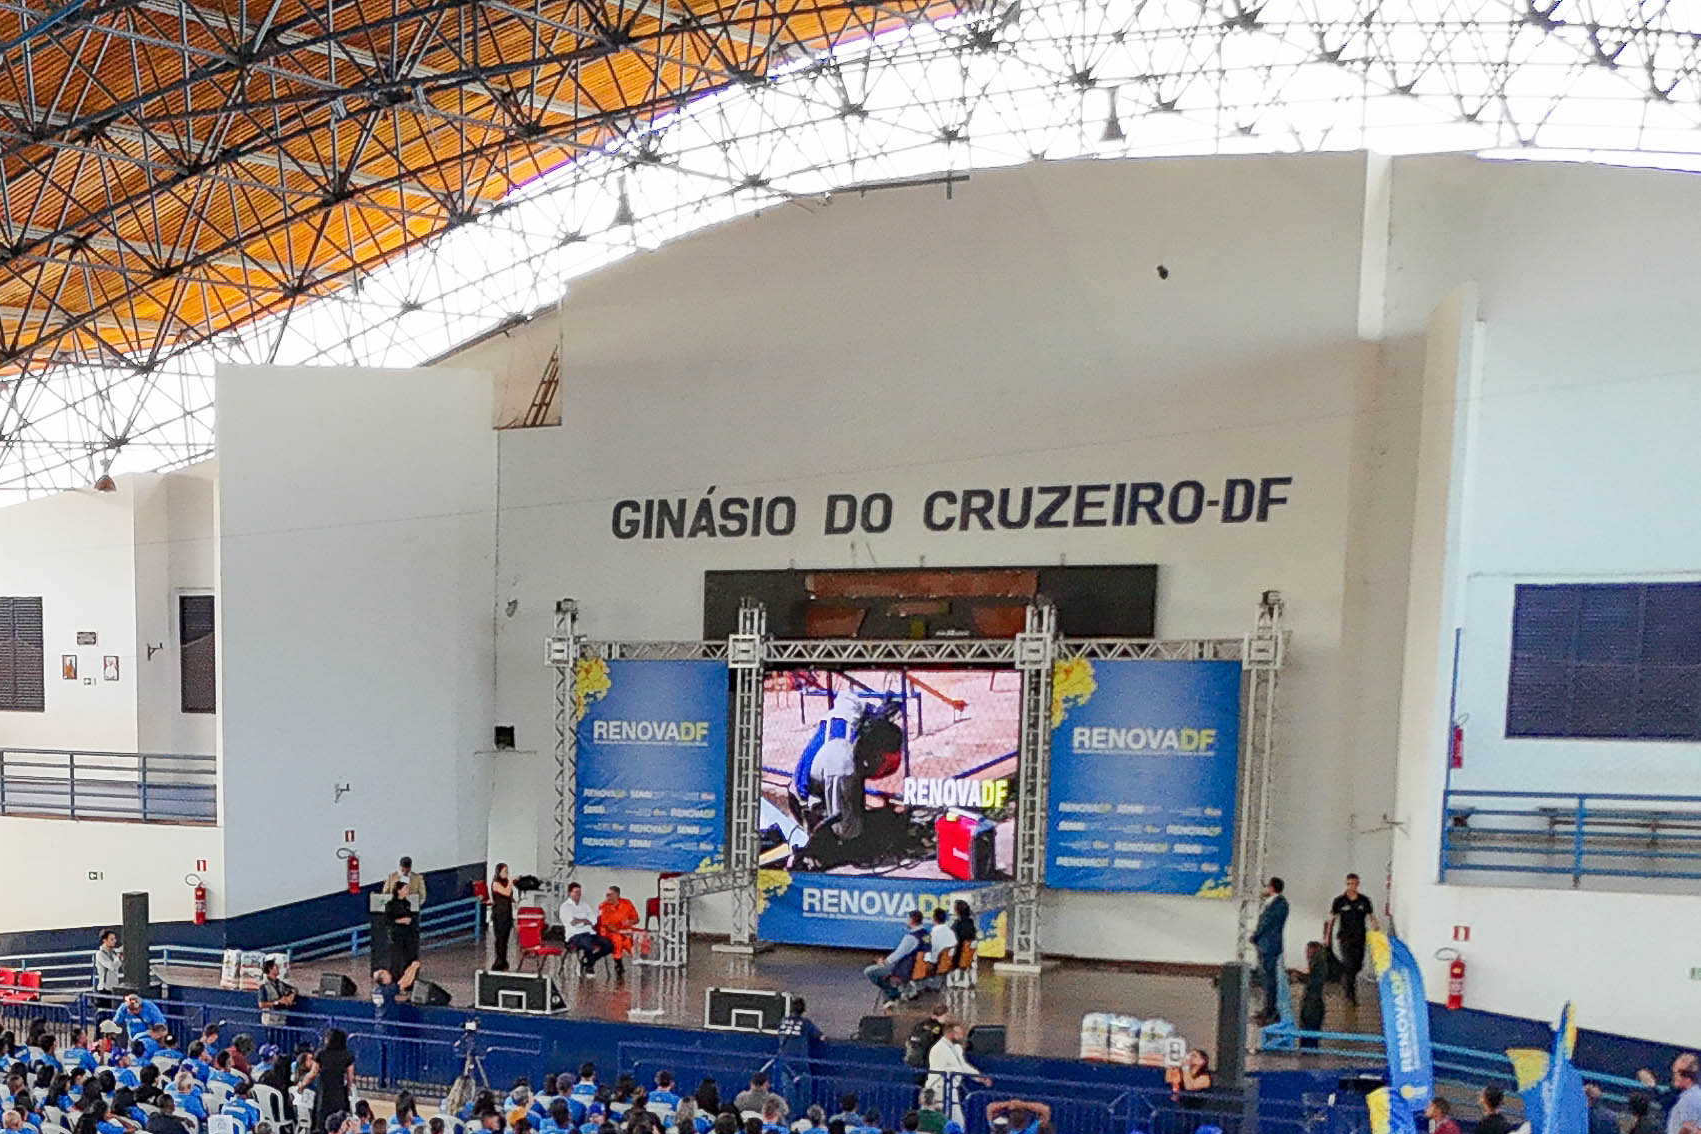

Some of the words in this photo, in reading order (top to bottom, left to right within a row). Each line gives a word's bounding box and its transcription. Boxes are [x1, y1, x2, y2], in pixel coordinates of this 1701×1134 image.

[611, 486, 796, 540] GINÁSIO
[824, 492, 893, 535] DO
[923, 476, 1292, 533] CRUZEIRO-DF
[593, 720, 709, 741] RENOVADF
[1072, 727, 1216, 750] RENOVADF
[903, 776, 1008, 808] RENOVADF
